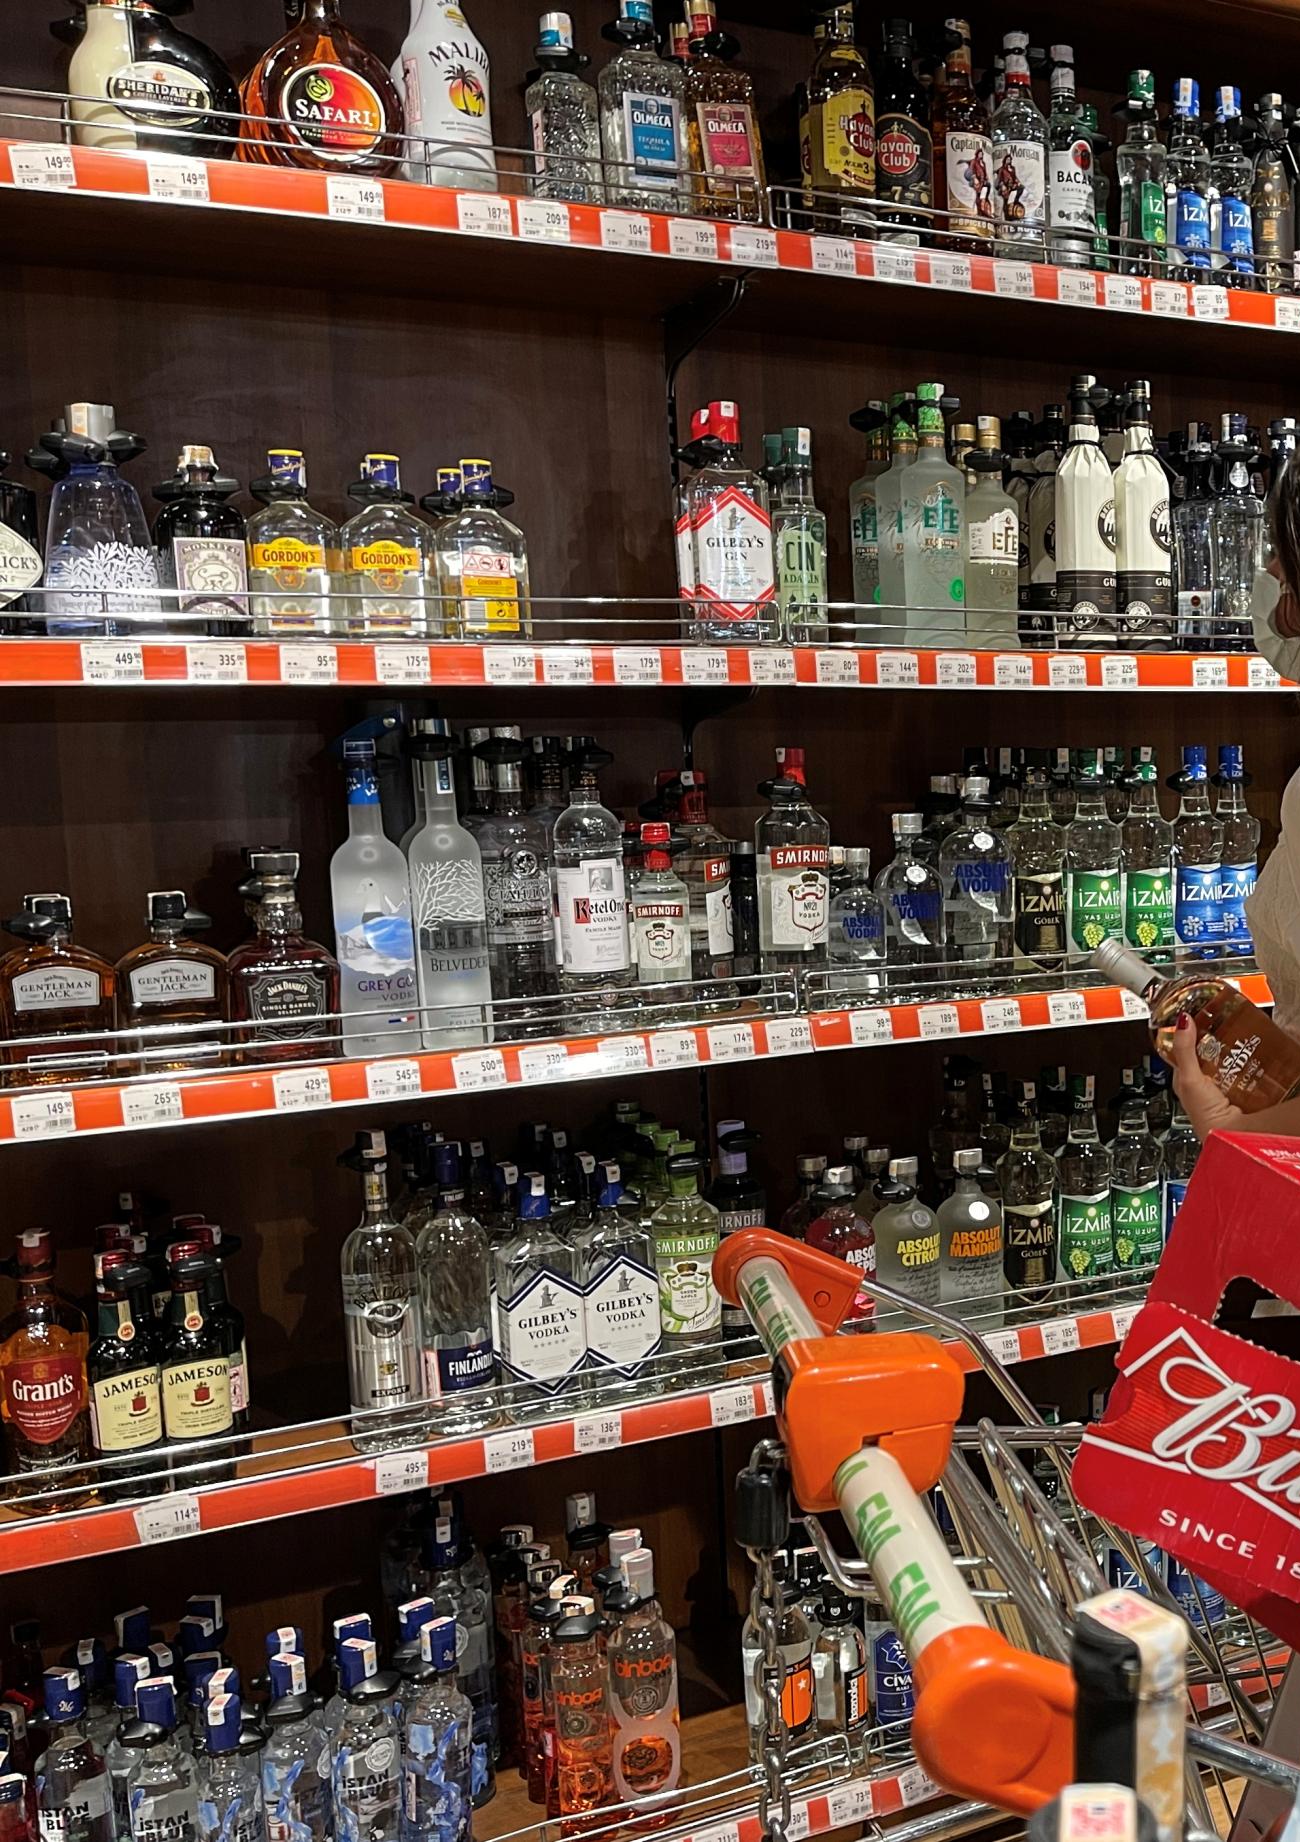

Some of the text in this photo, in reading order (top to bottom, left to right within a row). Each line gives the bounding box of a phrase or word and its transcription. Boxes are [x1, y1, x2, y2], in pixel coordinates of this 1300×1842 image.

[296, 98, 373, 126] SAFARI
[633, 110, 672, 128] OLMECA
[707, 120, 745, 135] OLMECA
[950, 136, 981, 152] Captain
[881, 153, 910, 168] Club
[1009, 145, 1041, 161] Morgan
[924, 497, 960, 535] EFE
[706, 536, 765, 549] GILBEY'S
[262, 549, 316, 564] GORDON'S
[361, 551, 414, 566] GORDON'S
[725, 552, 748, 561] GIN
[574, 897, 609, 924] Ketel
[636, 906, 682, 918] SMIRNOFF
[1084, 913, 1100, 922] YAŞ
[1138, 912, 1155, 921] YAŞ
[137, 972, 208, 986] GENTLEMAN
[358, 978, 393, 992] GREY
[20, 981, 93, 994] GENTLEMAN
[267, 981, 283, 996] JACK
[1113, 1200, 1158, 1223] İZMİR
[1066, 1213, 1111, 1234] İZMİR
[1008, 1223, 1054, 1246] İZMİR
[1117, 1227, 1135, 1237] YAŞ
[655, 1237, 716, 1254] SMIRNOFF
[1071, 1238, 1088, 1248] YAŞ
[596, 1291, 655, 1314] GILBEY'S
[518, 1307, 578, 1331] GILBEY'S
[606, 1308, 647, 1324] VODKA
[528, 1323, 570, 1341] VODKA
[168, 1364, 229, 1386] JAMESON
[12, 1373, 75, 1402] Grant's
[375, 1387, 407, 1396] EXPORT
[1157, 1507, 1257, 1563] SINCE
